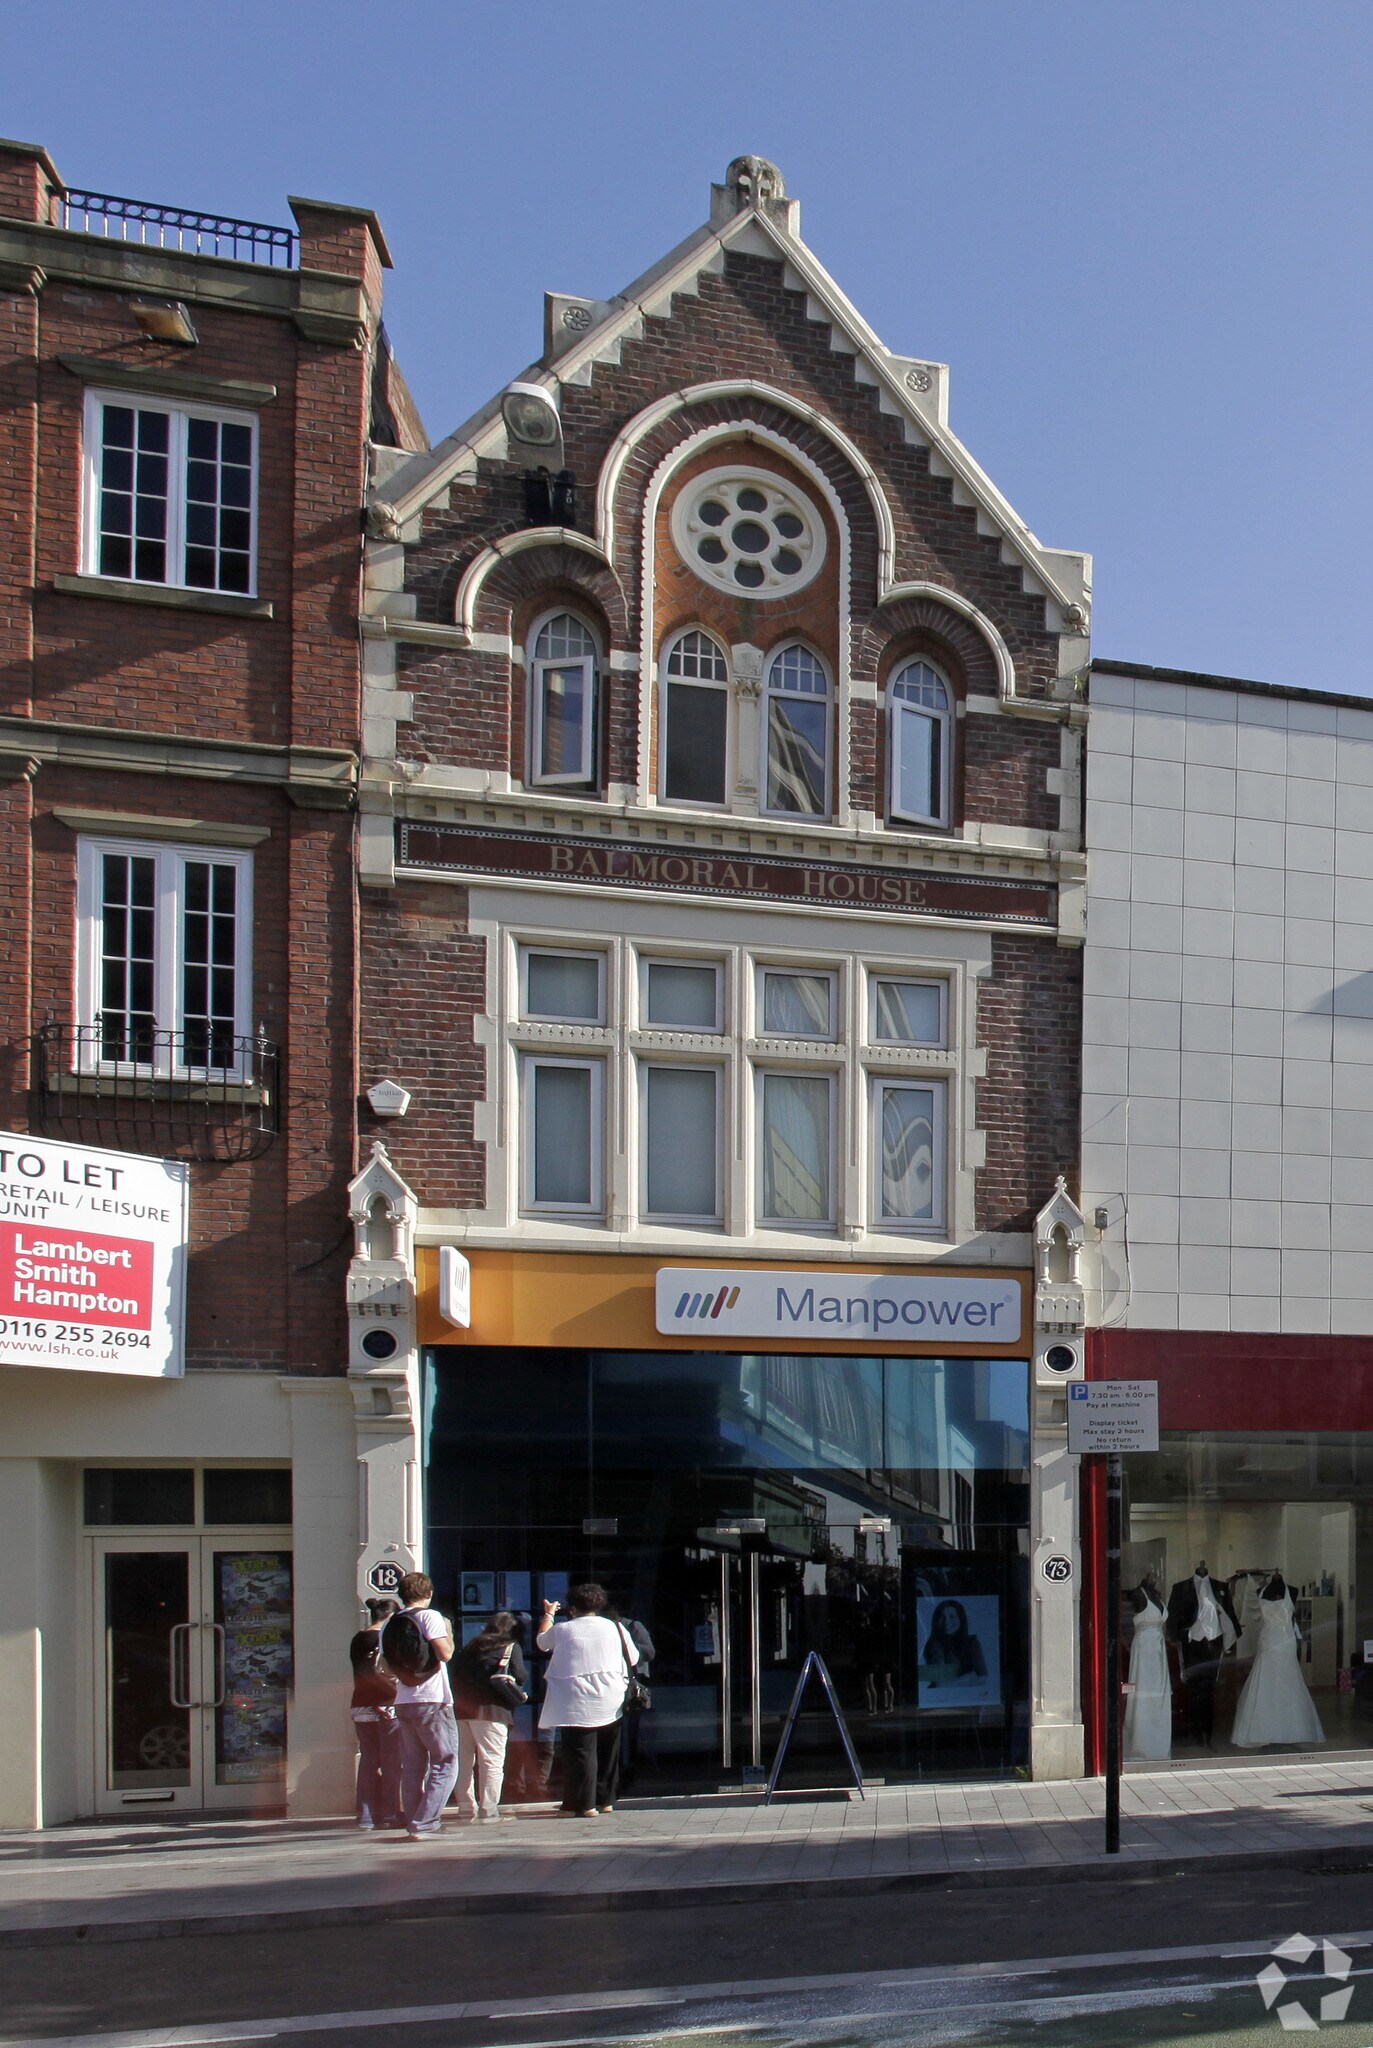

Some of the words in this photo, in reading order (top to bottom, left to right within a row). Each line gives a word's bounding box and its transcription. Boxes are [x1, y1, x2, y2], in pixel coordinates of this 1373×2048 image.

[550, 846, 769, 890] BALMORAL
[803, 869, 926, 905] HOUSE
[0, 1149, 46, 1178] TO
[63, 1160, 124, 1190] LET
[91, 1197, 170, 1223] LEISURE
[15, 1233, 132, 1269] Lambert
[14, 1258, 97, 1287] Smith
[13, 1281, 138, 1315] Hampton
[776, 1287, 1005, 1332] Manpower
[55, 1325, 95, 1343] 255
[101, 1330, 151, 1349] 2694
[378, 1569, 398, 1586] 18
[1049, 1561, 1067, 1578] 73
